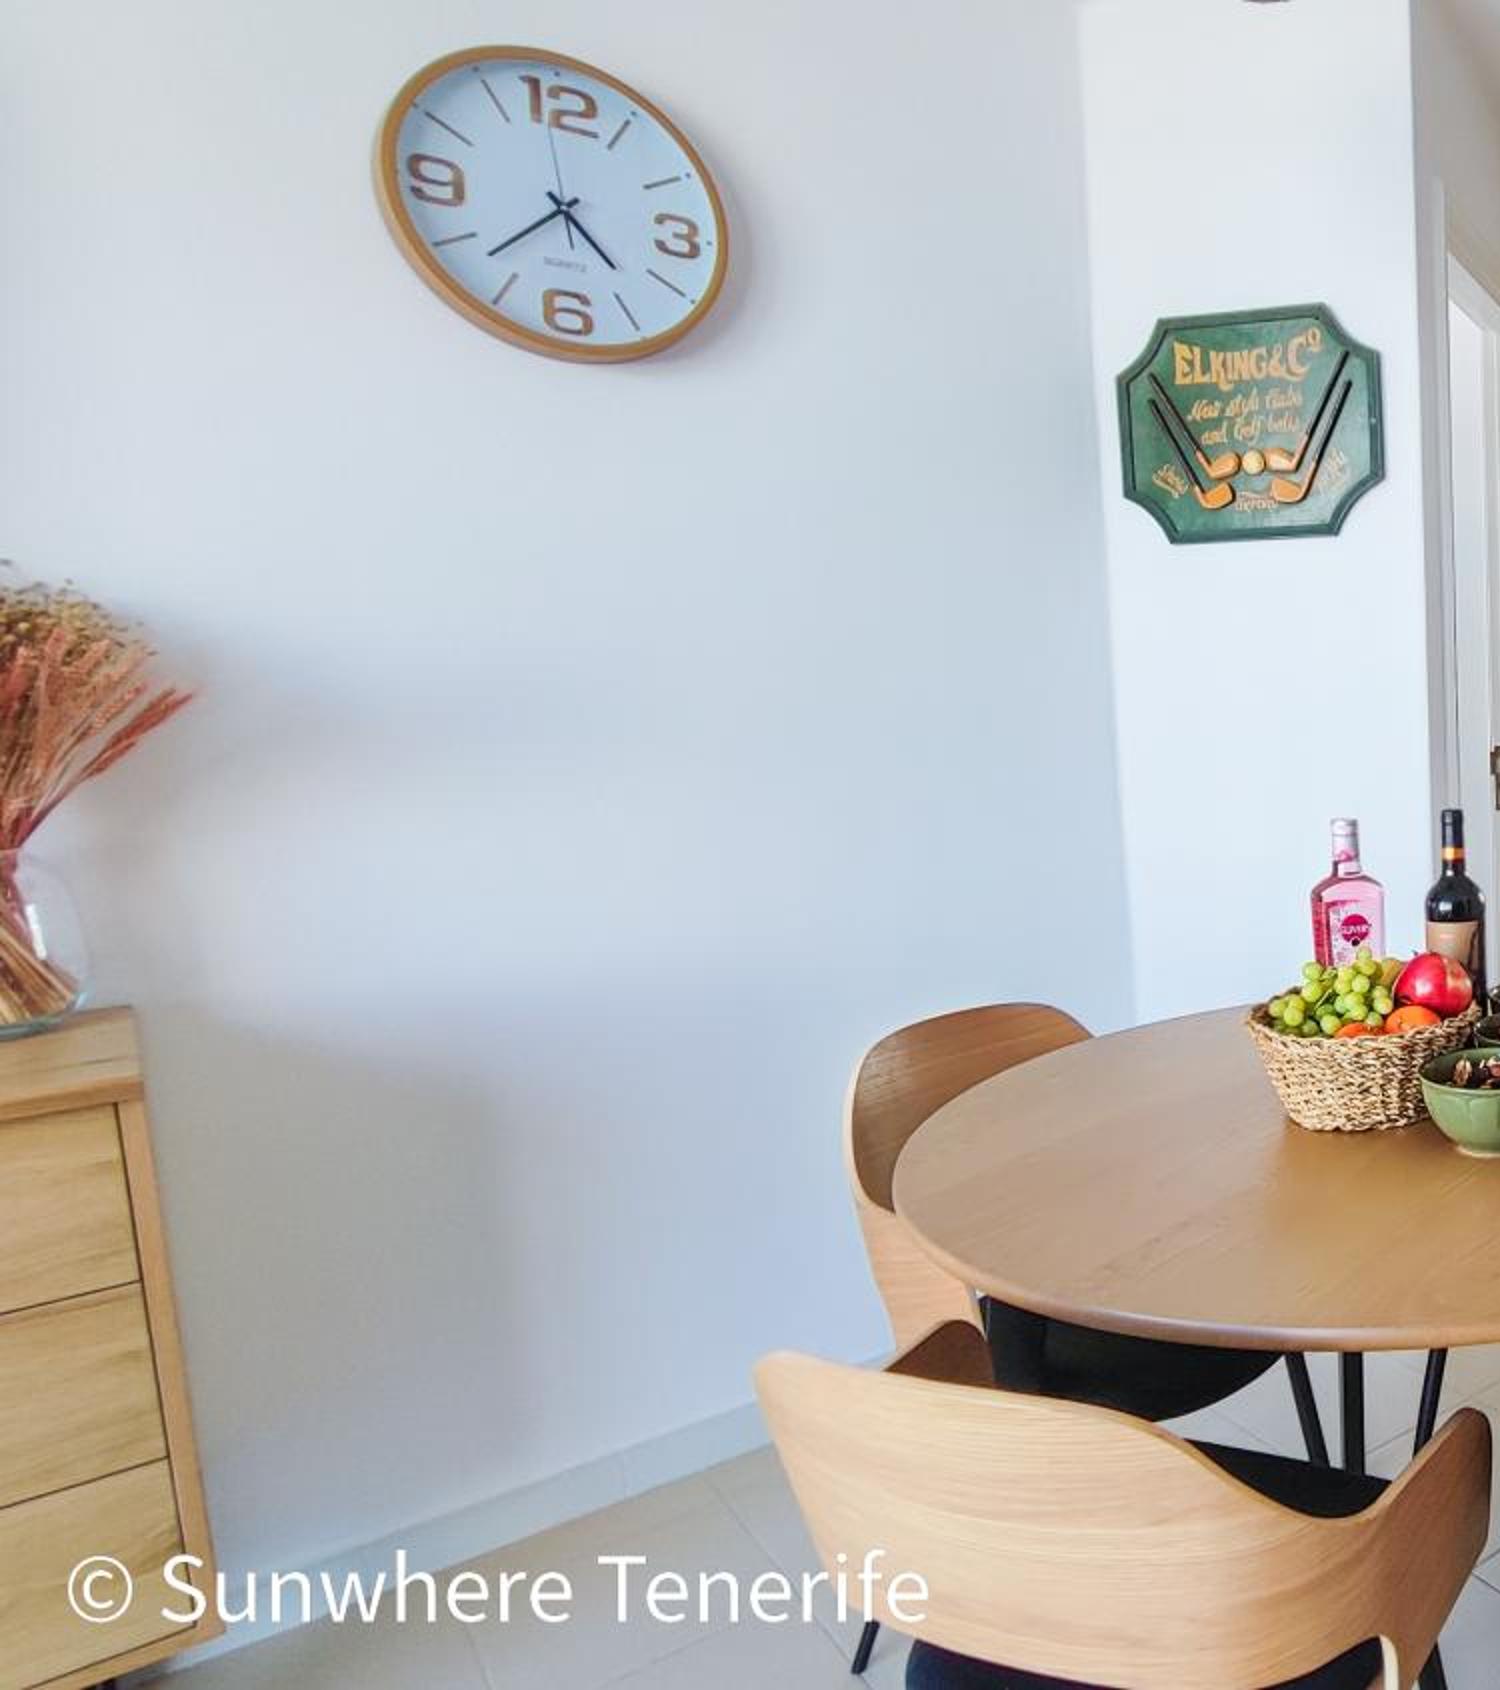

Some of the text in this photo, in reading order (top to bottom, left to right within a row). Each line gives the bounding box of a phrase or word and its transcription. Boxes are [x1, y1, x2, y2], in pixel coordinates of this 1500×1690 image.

[518, 75, 600, 139] 12
[406, 152, 466, 207] 9
[653, 212, 702, 260] 3
[541, 288, 595, 337] 6
